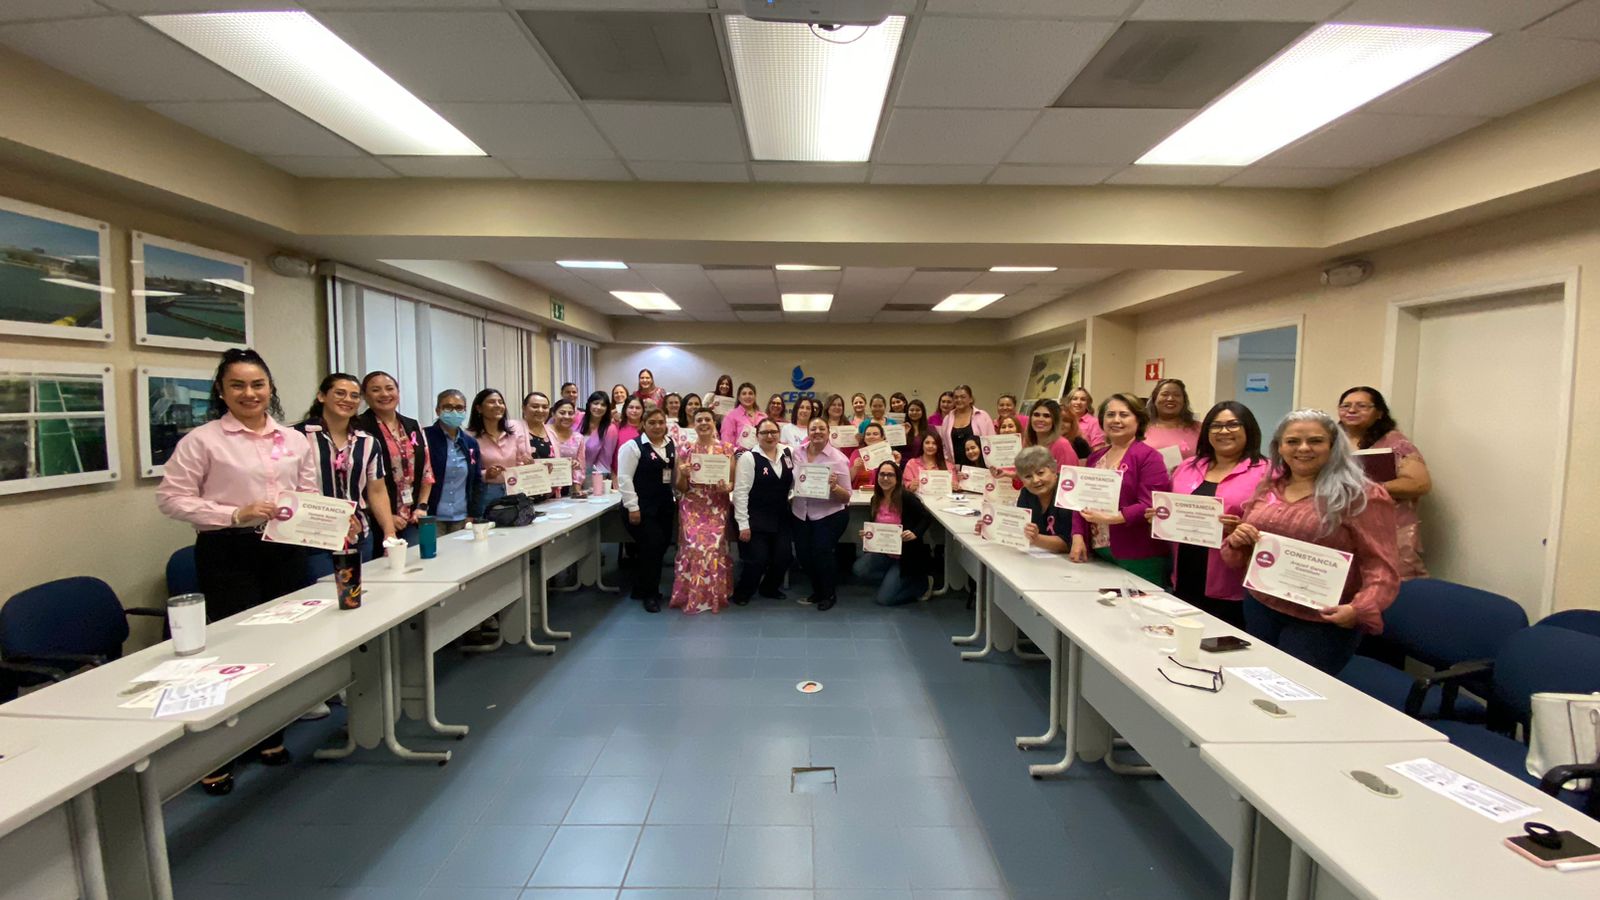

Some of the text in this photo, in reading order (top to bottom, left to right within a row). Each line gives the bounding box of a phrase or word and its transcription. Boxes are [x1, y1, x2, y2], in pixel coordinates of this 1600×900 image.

[302, 503, 346, 514] CONSTANCIA
[1174, 502, 1216, 511] CONSTANCIA
[1284, 549, 1338, 568] CONSTANCIA
